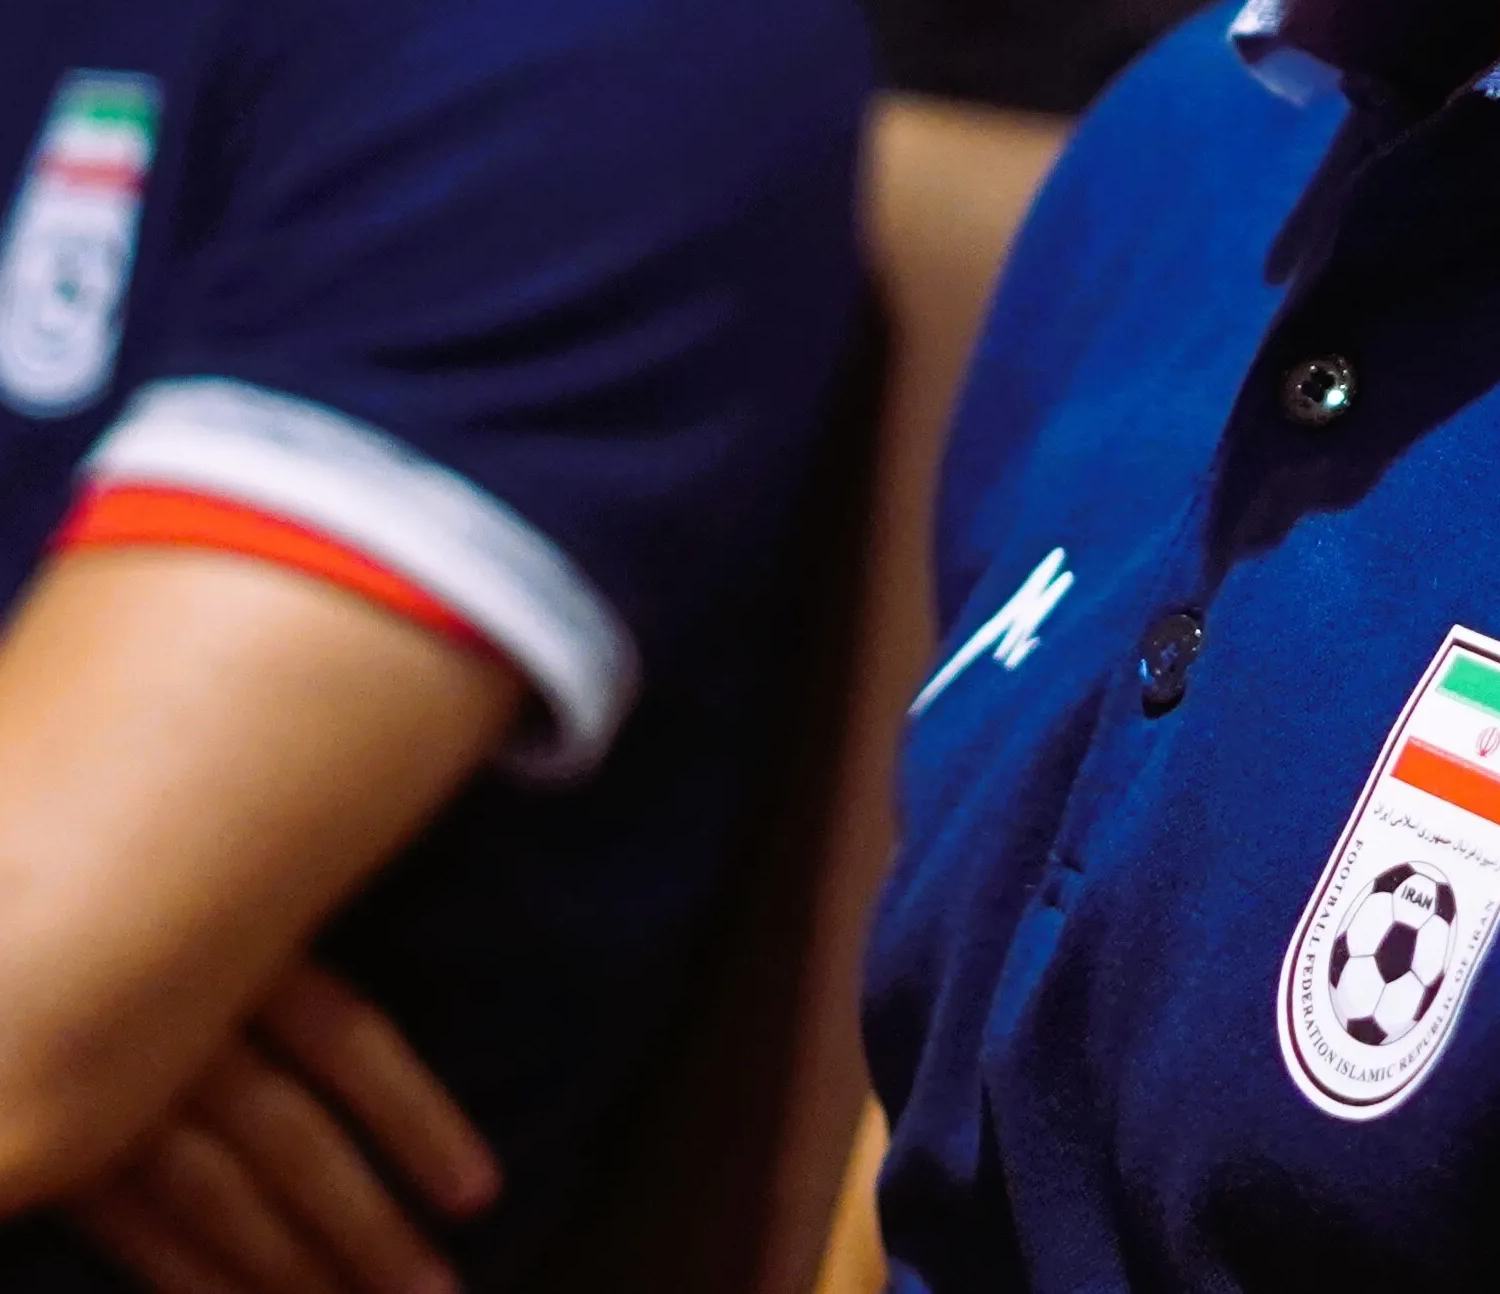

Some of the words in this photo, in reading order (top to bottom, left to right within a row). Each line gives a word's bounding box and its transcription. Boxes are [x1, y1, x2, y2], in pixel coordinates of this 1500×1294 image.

[1309, 839, 1364, 946] FOOTBALL
[1401, 884, 1434, 910] IRAN
[1468, 900, 1495, 950] IRAN
[1454, 959, 1468, 983] OF
[1301, 953, 1338, 1065] FEDERATION
[1399, 992, 1453, 1072] REPUBLIC
[1335, 1057, 1396, 1083] ISLAMIC
